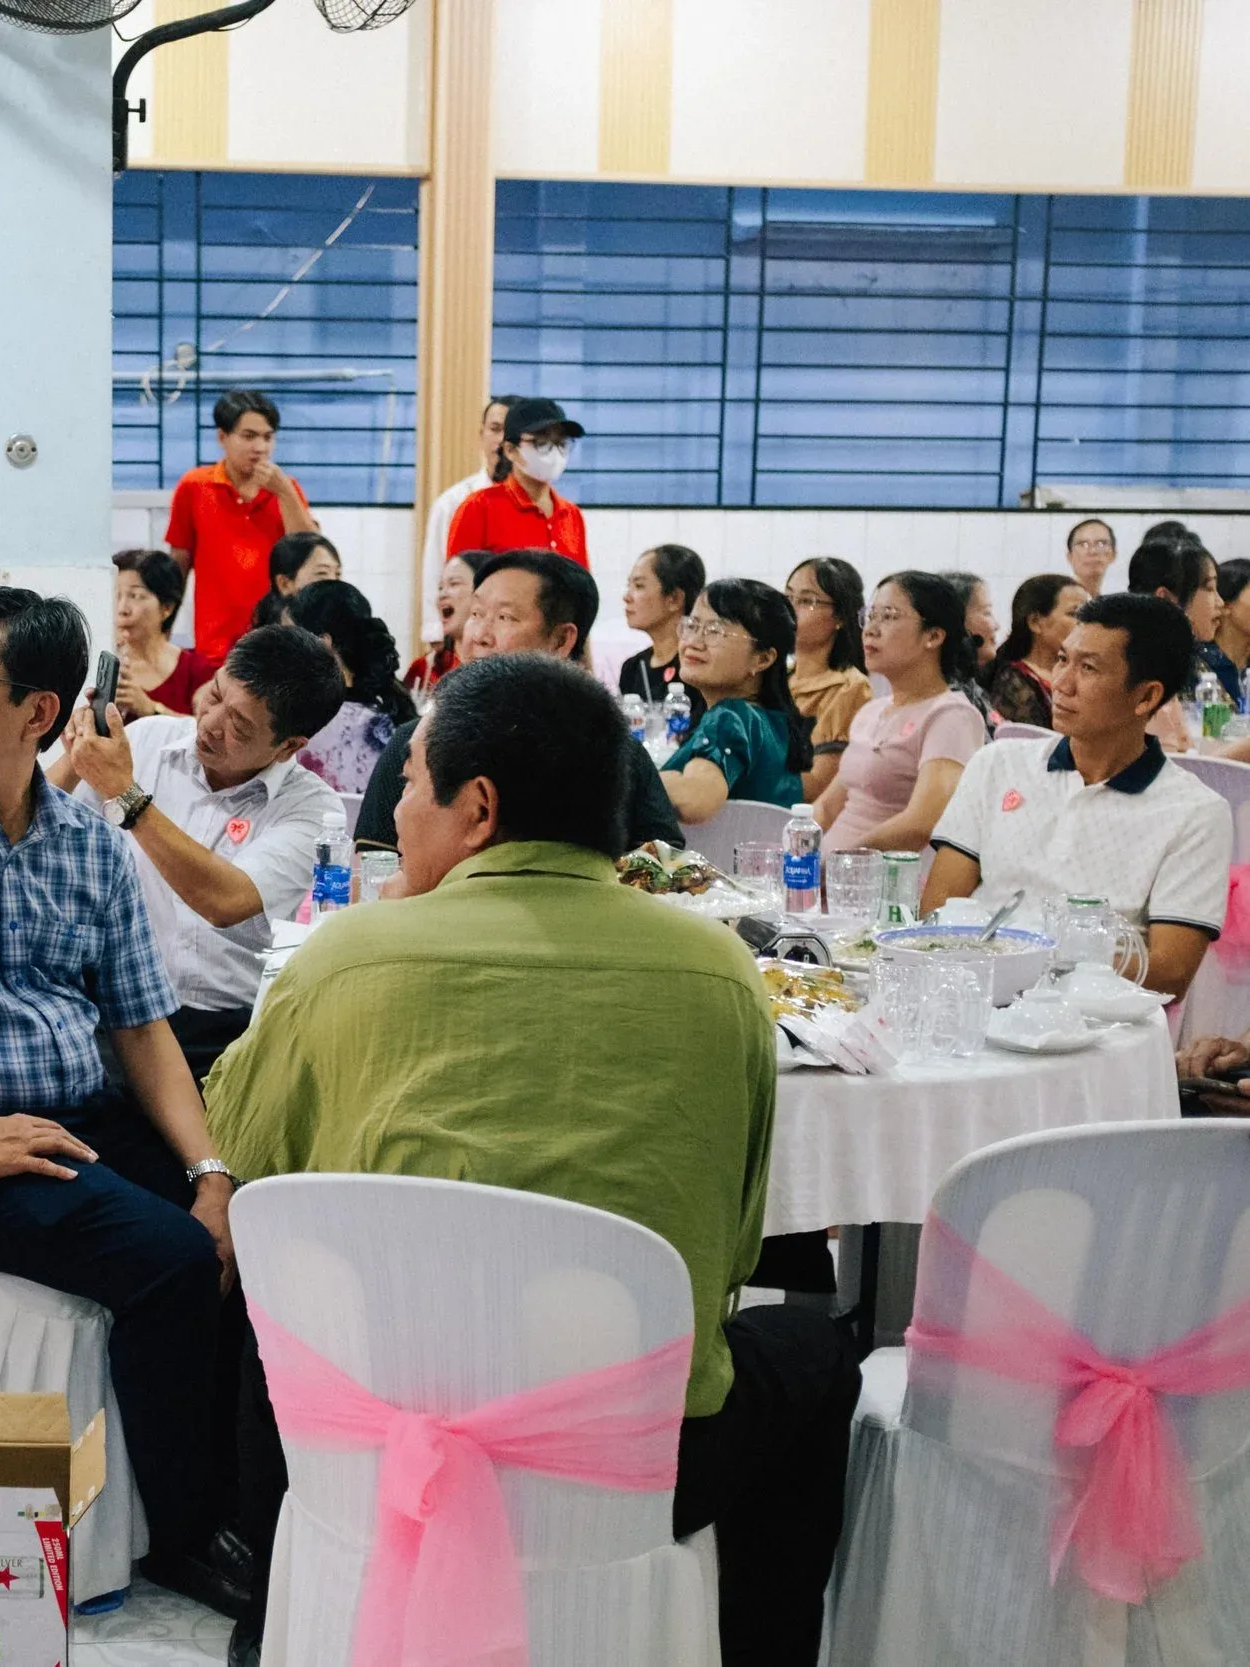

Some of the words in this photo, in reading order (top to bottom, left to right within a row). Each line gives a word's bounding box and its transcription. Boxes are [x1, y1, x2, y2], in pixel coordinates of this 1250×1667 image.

[41, 1537, 56, 1564] LIMITED
[50, 1564, 65, 1591] EDITION
[51, 1537, 65, 1560] 250ML
